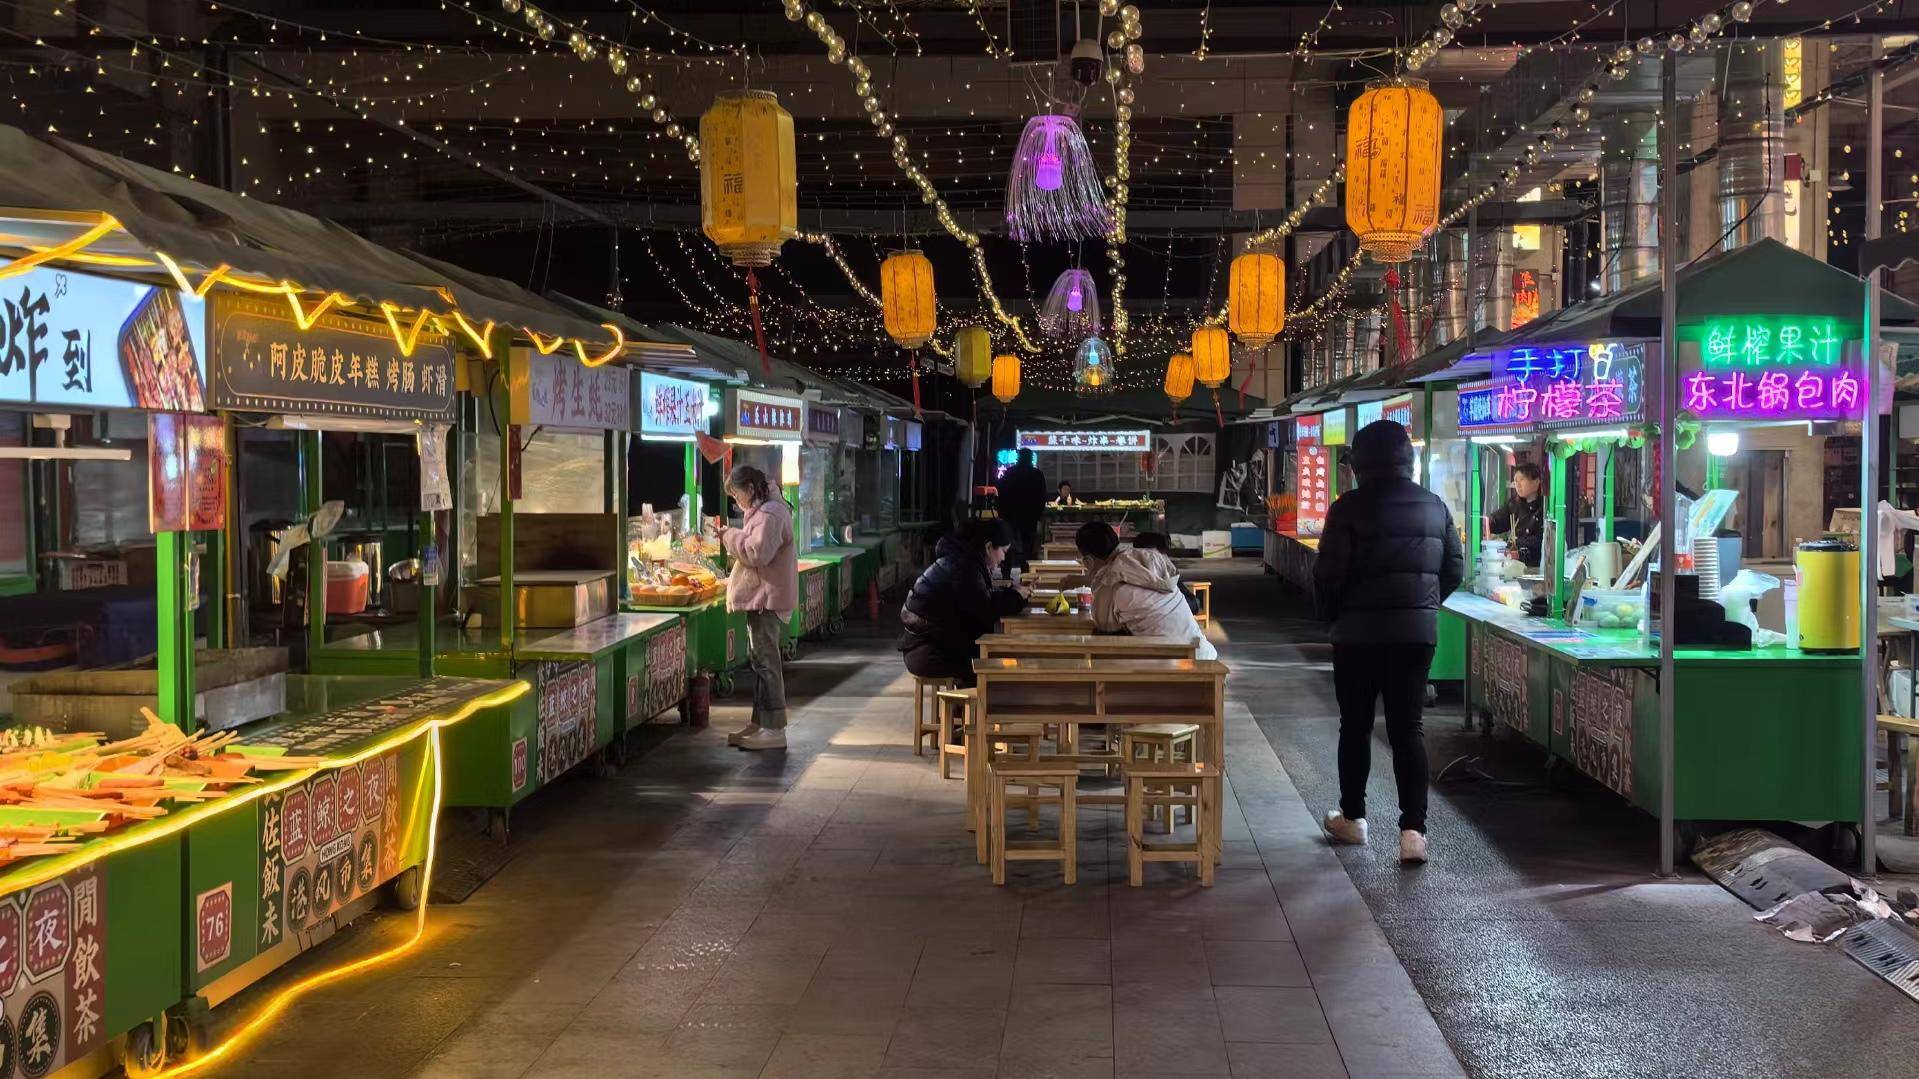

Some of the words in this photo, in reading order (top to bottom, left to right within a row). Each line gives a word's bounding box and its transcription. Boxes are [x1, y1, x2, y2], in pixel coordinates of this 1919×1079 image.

[1507, 348, 1587, 381] 手打
[1708, 325, 1838, 364] 鲜榨果汁
[270, 342, 379, 389] 阿皮脆皮年糕
[386, 357, 414, 393] 烤肠
[421, 364, 447, 397] 虾滑
[1497, 379, 1624, 419] 柠檬茶
[1688, 370, 1858, 410] 东北锅包肉
[288, 774, 382, 846] 蓝鲸之夜
[291, 841, 374, 920] 港风市集
[206, 912, 224, 942] 76
[73, 864, 99, 1045] 閒飲茶
